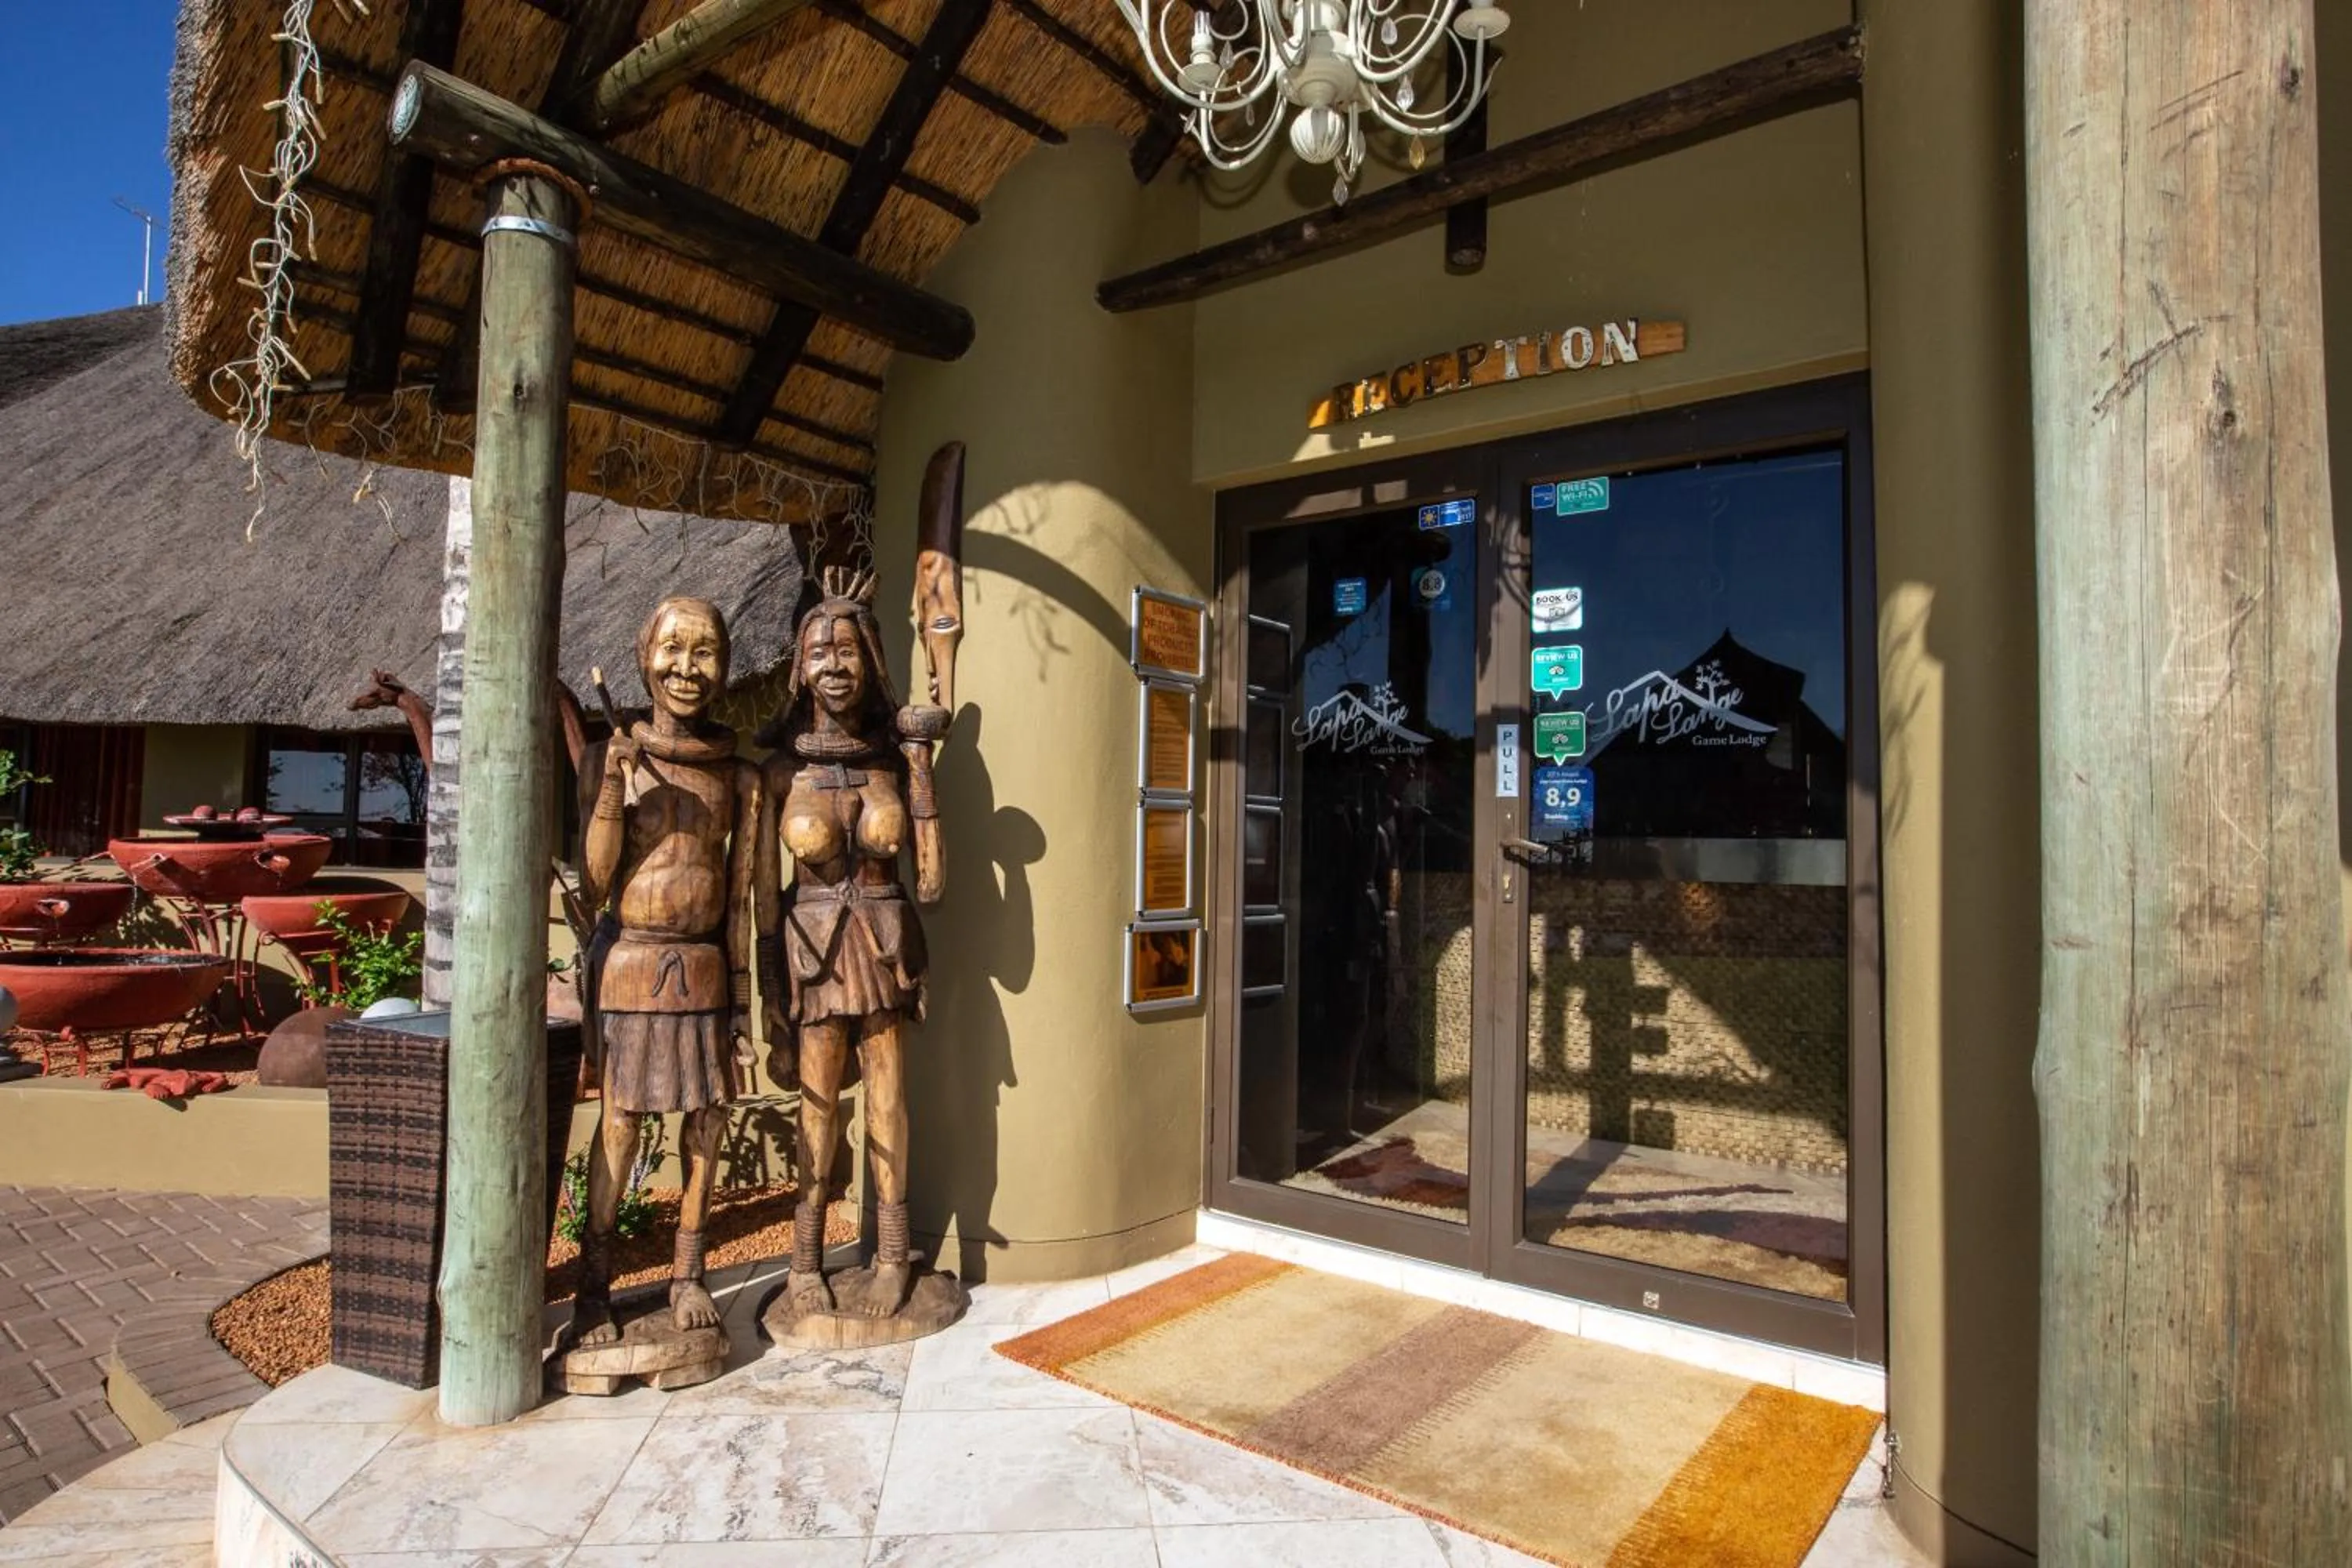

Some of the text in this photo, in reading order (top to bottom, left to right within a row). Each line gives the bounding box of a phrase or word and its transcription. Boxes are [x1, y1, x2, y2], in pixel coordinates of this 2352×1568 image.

[1332, 317, 1639, 422] RECEPTION
[1536, 594, 1562, 604] BOOK
[1584, 677, 1682, 743] Lapa
[1692, 734, 1766, 746] Game Lodge
[1503, 731, 1513, 791] PULL
[1545, 787, 1581, 808] 8,9
